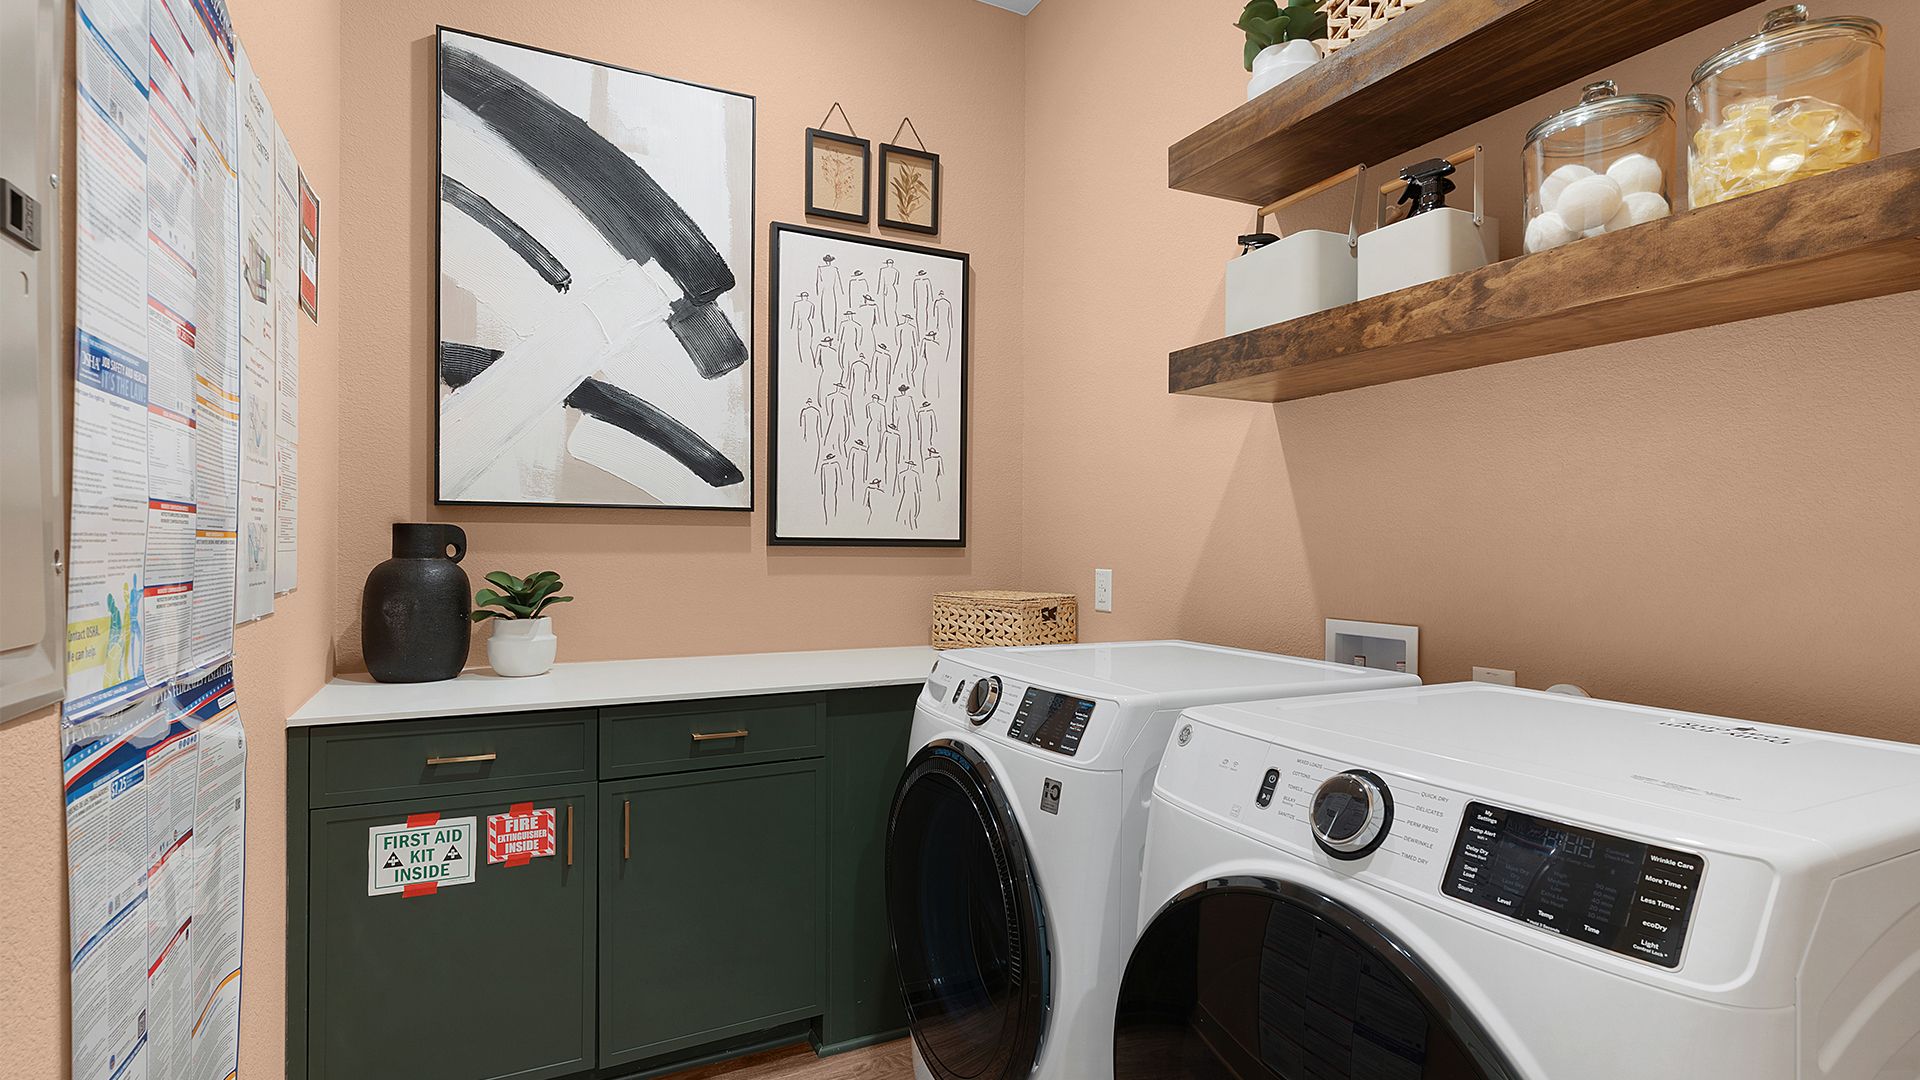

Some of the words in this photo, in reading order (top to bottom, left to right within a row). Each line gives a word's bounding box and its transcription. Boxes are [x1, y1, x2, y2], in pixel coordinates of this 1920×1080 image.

[1292, 770, 1311, 780] COTTONS
[1288, 783, 1303, 792] TOWELS
[1420, 791, 1438, 800] QUICK
[1438, 795, 1449, 804] DRY
[1416, 804, 1444, 818] DELICATES
[505, 817, 539, 833] FIRE
[1477, 814, 1498, 824] Settings
[1406, 820, 1422, 828] PERM
[1422, 824, 1440, 834] PRESS
[384, 832, 430, 850] FIRST
[434, 829, 463, 845] AID
[498, 829, 547, 844] EXTINGUISHER
[1484, 830, 1497, 838] Alert
[505, 840, 540, 854] INSIDE
[1404, 835, 1434, 850] DEWRINKLE
[410, 848, 436, 864] KIT
[1466, 844, 1480, 854] Delay
[1480, 848, 1490, 856] Dry
[1402, 852, 1417, 862] TIMED
[1417, 857, 1429, 866] DRY
[1650, 855, 1676, 867] Wrinkle
[1676, 861, 1695, 870] Care
[394, 863, 450, 882] INSIDE
[1462, 870, 1476, 879] Load
[1464, 864, 1478, 873] Small
[1457, 883, 1474, 894] Sound
[1644, 874, 1664, 884] More
[1664, 879, 1682, 890] Time
[1497, 896, 1512, 906] Level
[1640, 896, 1657, 906] Less
[1657, 900, 1675, 911] Time
[1538, 908, 1554, 920] Temp
[1584, 924, 1600, 936] Time
[1642, 920, 1668, 933] ecoDry
[1632, 943, 1652, 954] Control
[1652, 949, 1664, 958] Lock
[1641, 939, 1660, 950] Light
